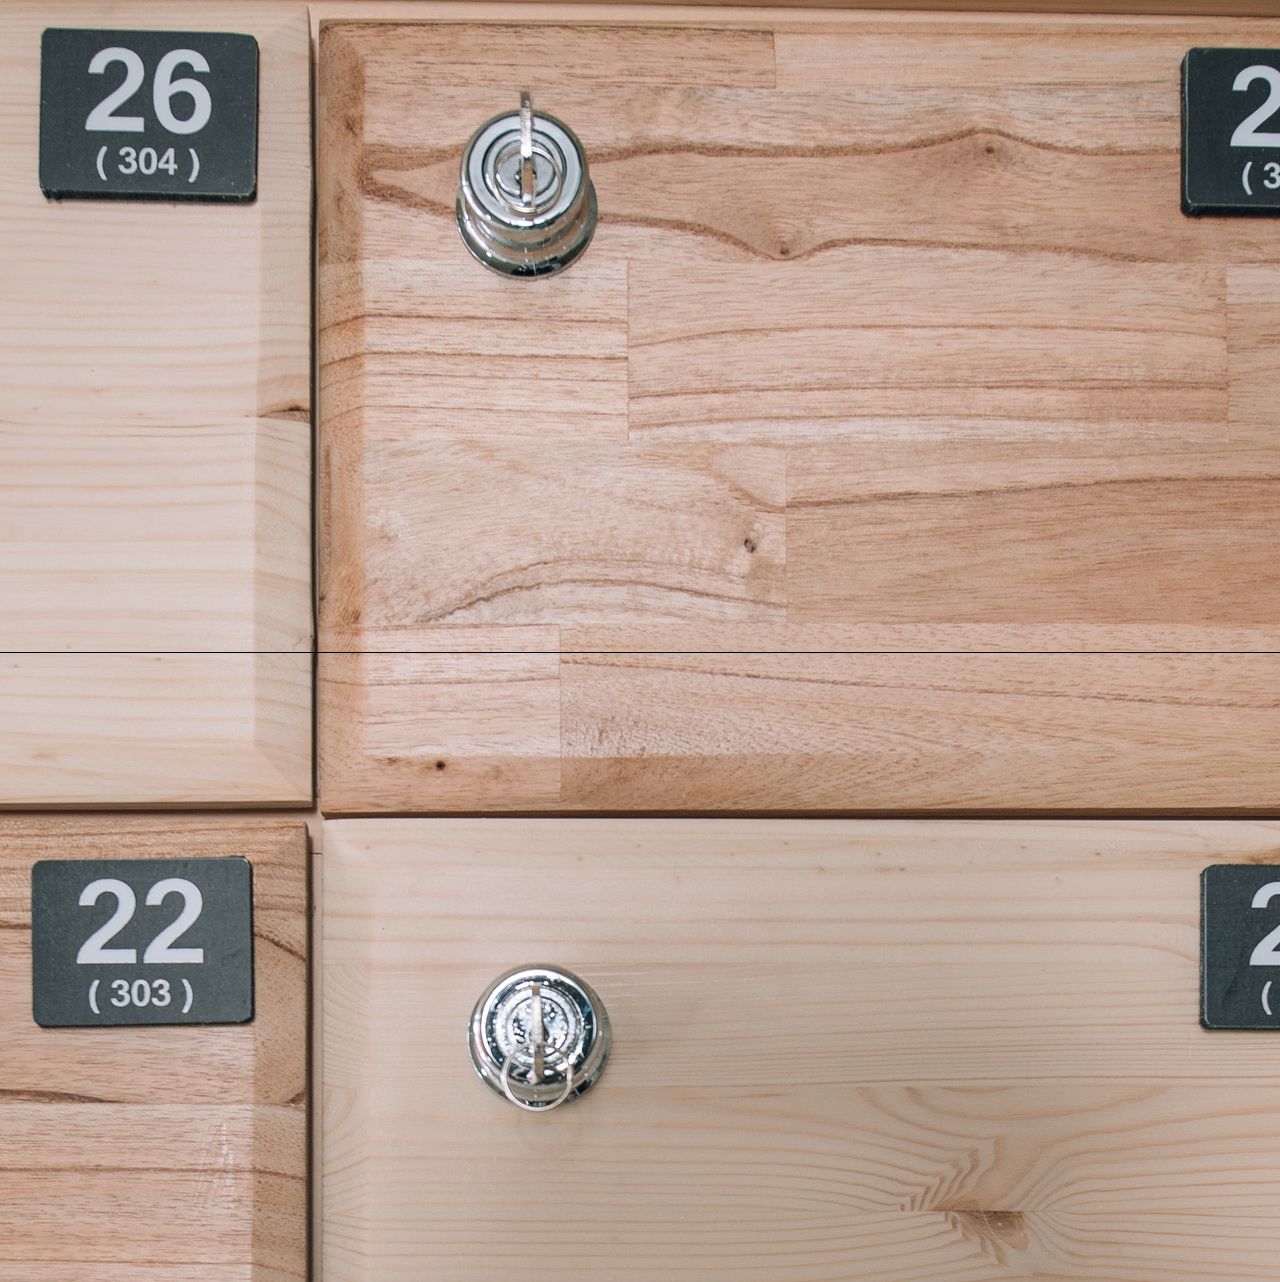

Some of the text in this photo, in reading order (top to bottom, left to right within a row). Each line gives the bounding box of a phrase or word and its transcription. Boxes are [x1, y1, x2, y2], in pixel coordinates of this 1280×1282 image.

[83, 46, 213, 135] 26
[96, 145, 200, 184] (304)
[75, 877, 206, 965] 22
[88, 978, 194, 1015] (303)
